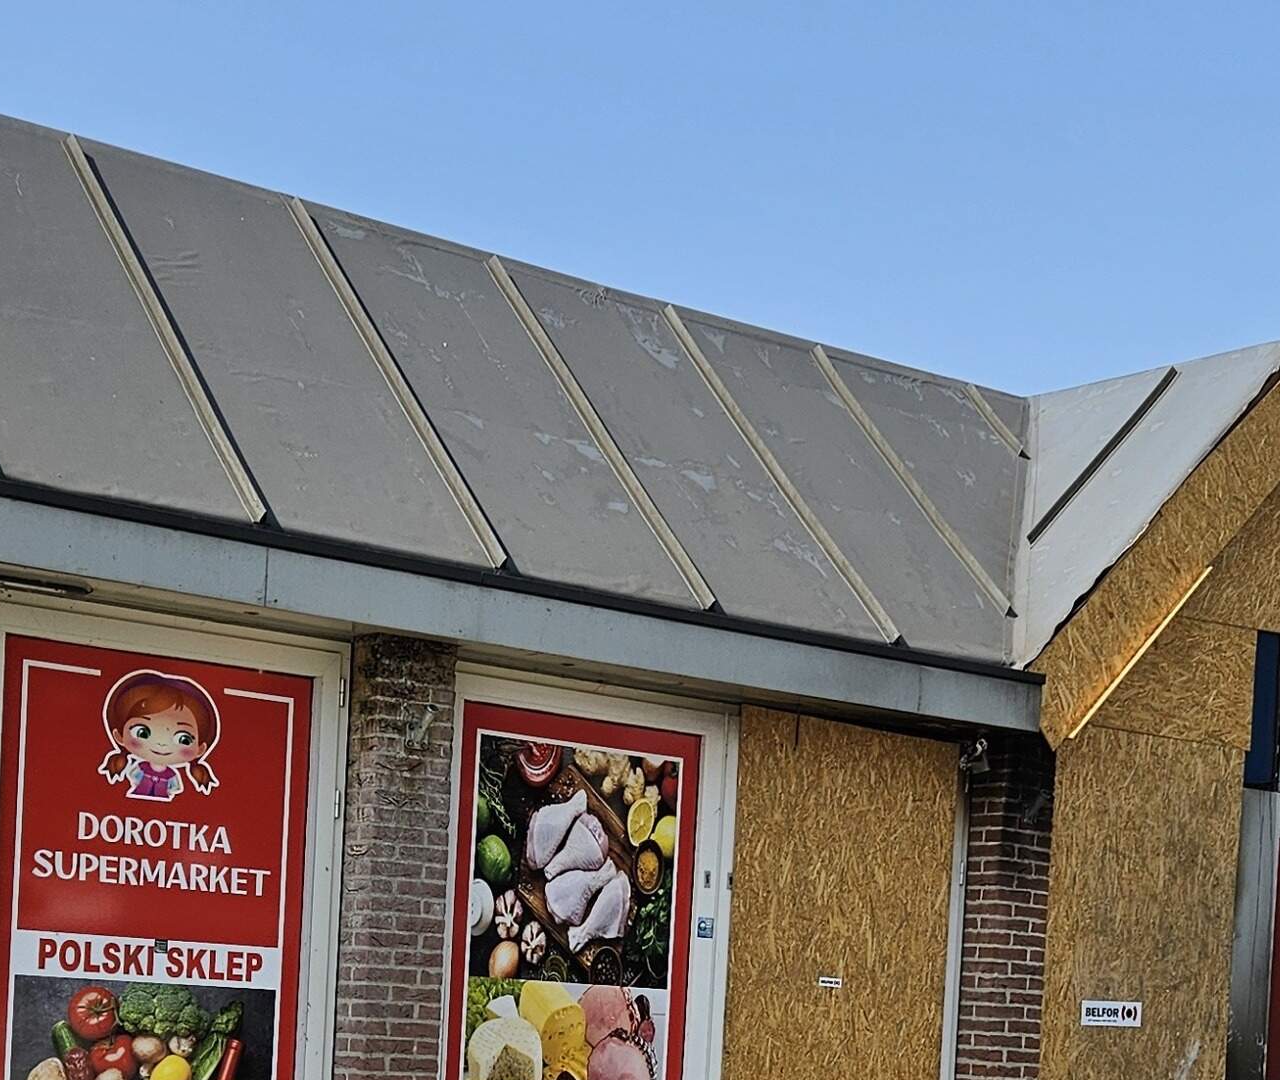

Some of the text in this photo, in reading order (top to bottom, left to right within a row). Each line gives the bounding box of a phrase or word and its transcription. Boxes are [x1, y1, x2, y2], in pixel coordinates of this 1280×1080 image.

[78, 811, 232, 854] DOROTKA
[32, 848, 271, 897] SUPERMARKET
[37, 938, 263, 983] POLSKI SKLEP
[1085, 1007, 1120, 1019] BELFOR
